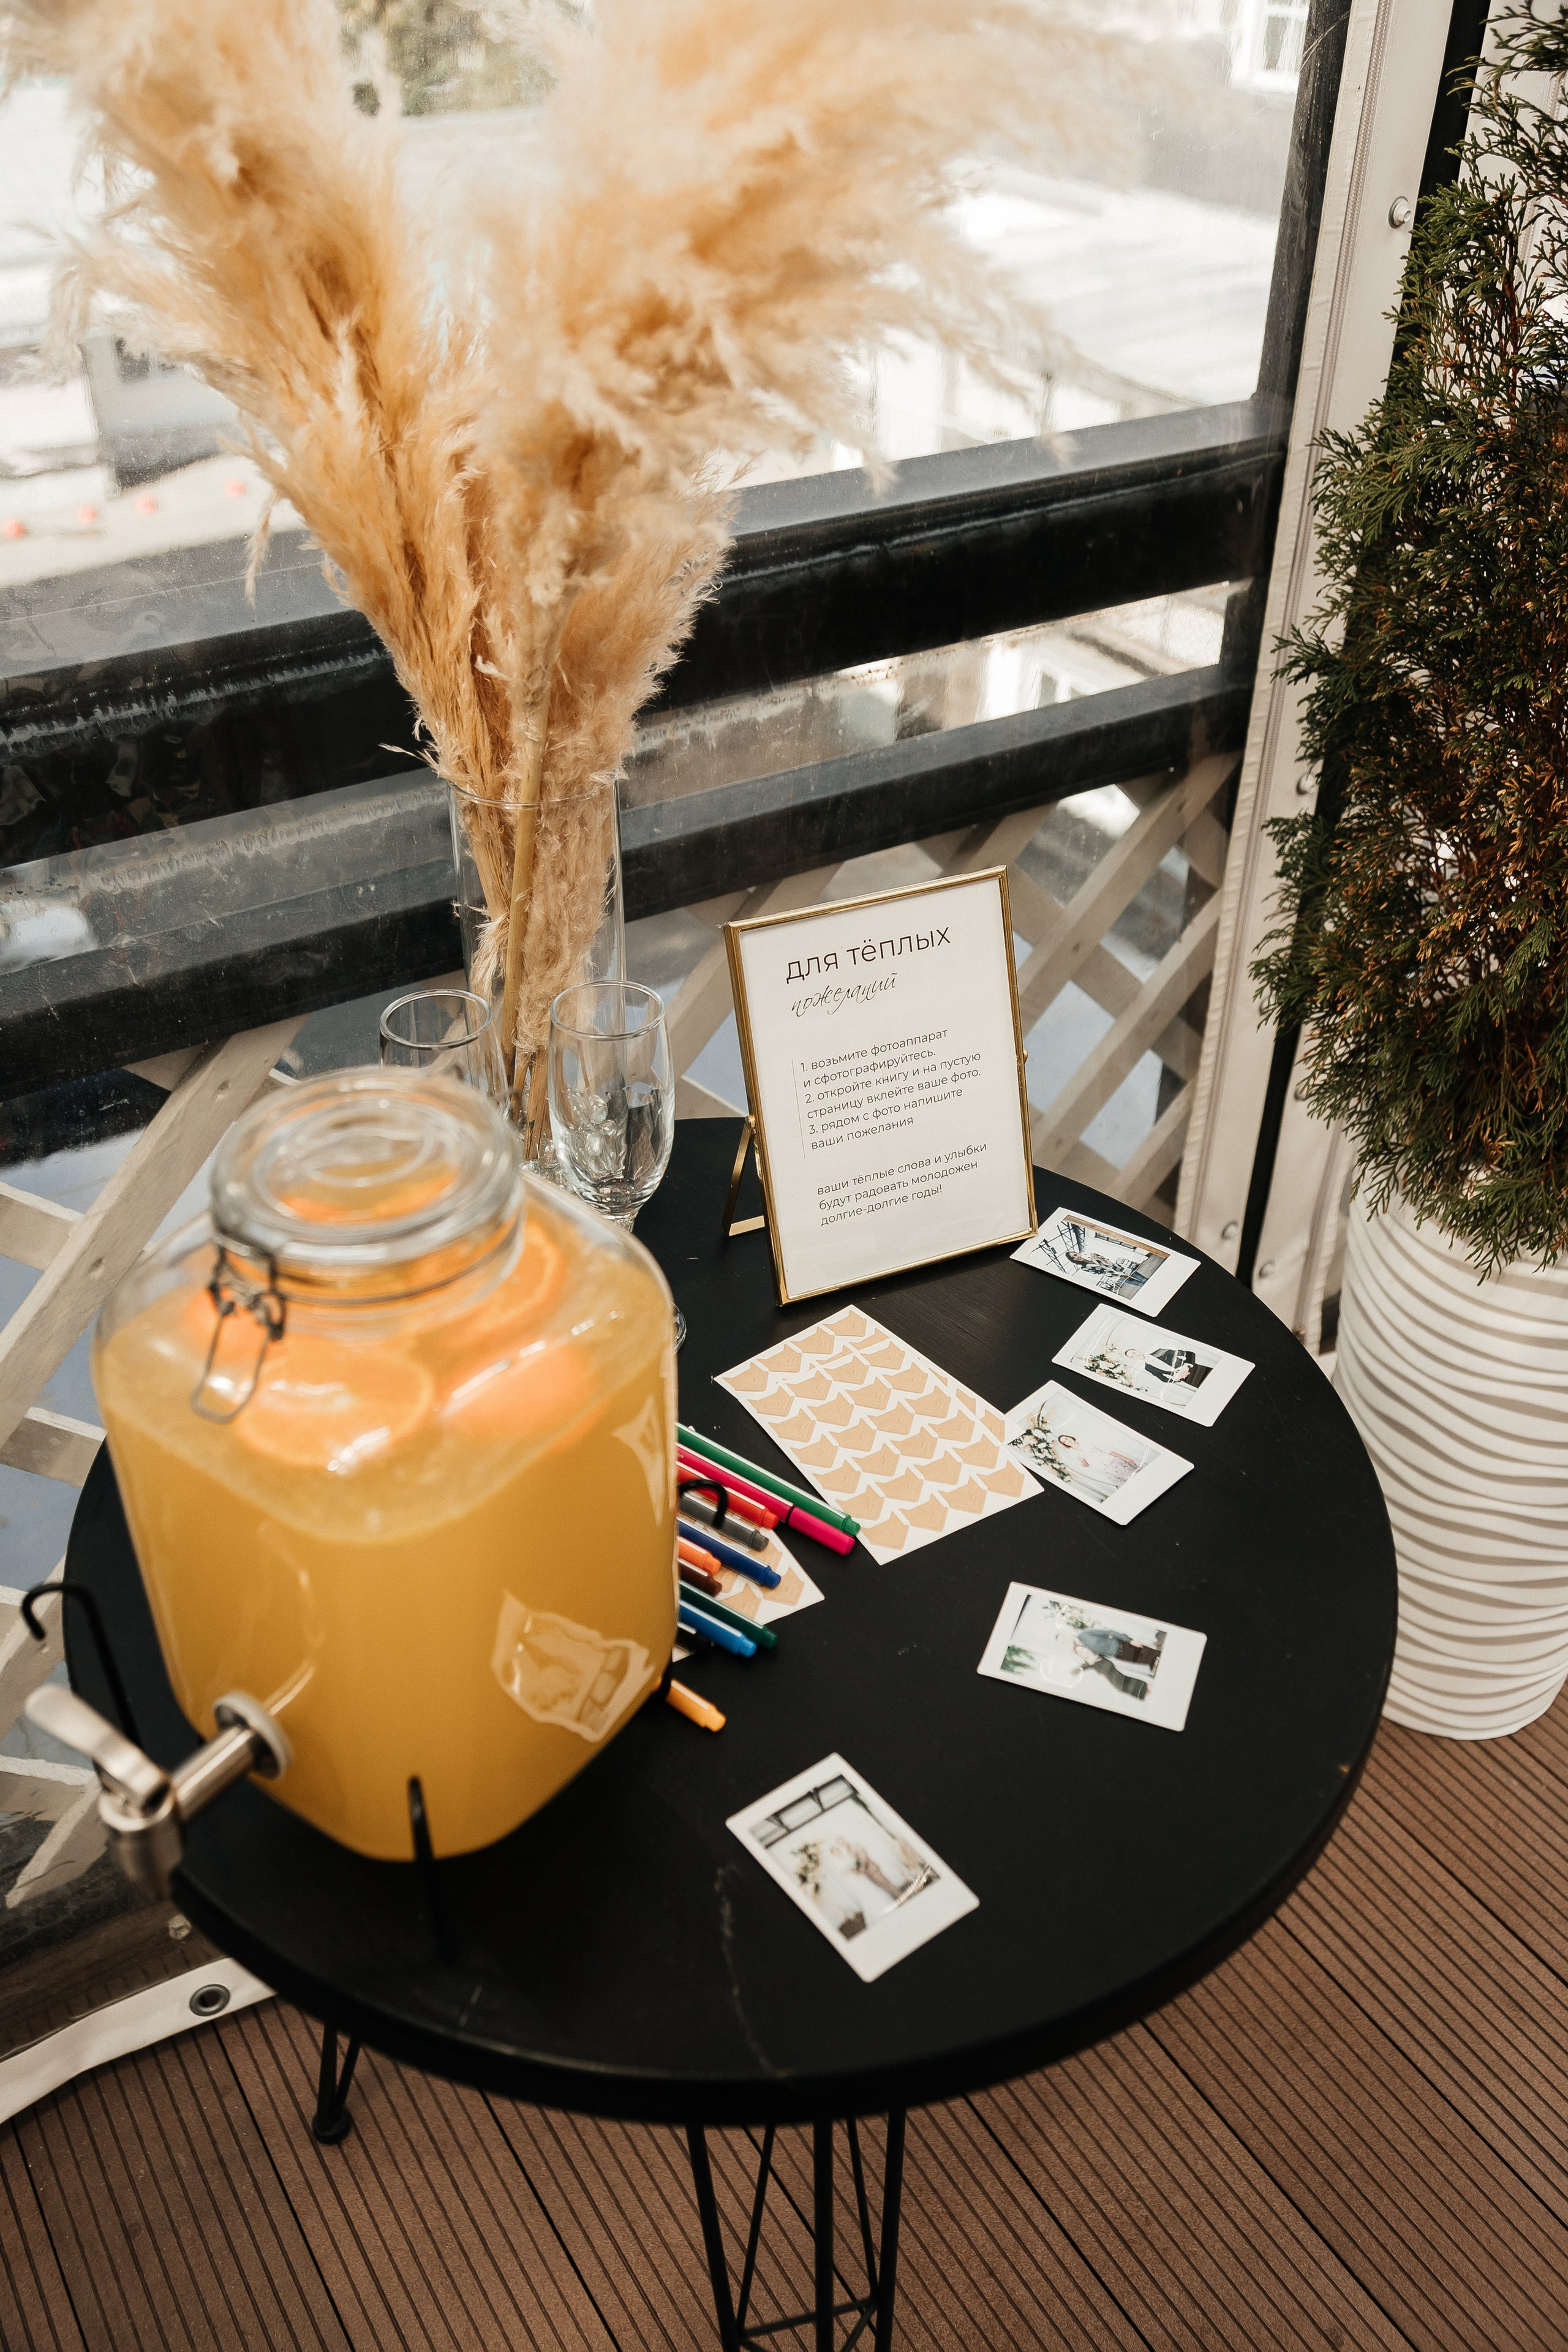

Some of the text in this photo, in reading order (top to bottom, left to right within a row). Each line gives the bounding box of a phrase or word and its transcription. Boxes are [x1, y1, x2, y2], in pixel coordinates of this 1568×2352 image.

[786, 927, 951, 985] для тёплых
[791, 972, 898, 1017] пожеланий
[800, 1029, 948, 1072] 1. возьмите фотоаппарат
[803, 1050, 936, 1088] и сфотографируйтесь.
[804, 1053, 981, 1104] 2. откройте книгу и на пустую
[807, 1069, 981, 1119] страницу вклейте ваше фото.
[808, 1088, 963, 1135] 3. рядом с фото напишите
[811, 1117, 914, 1150] ваши пожелания
[817, 1144, 987, 1196] ваши тёплые слова и улыбки
[819, 1161, 978, 1211] будут радовать молодожен
[821, 1183, 942, 1227] долгие-долгие годы!
